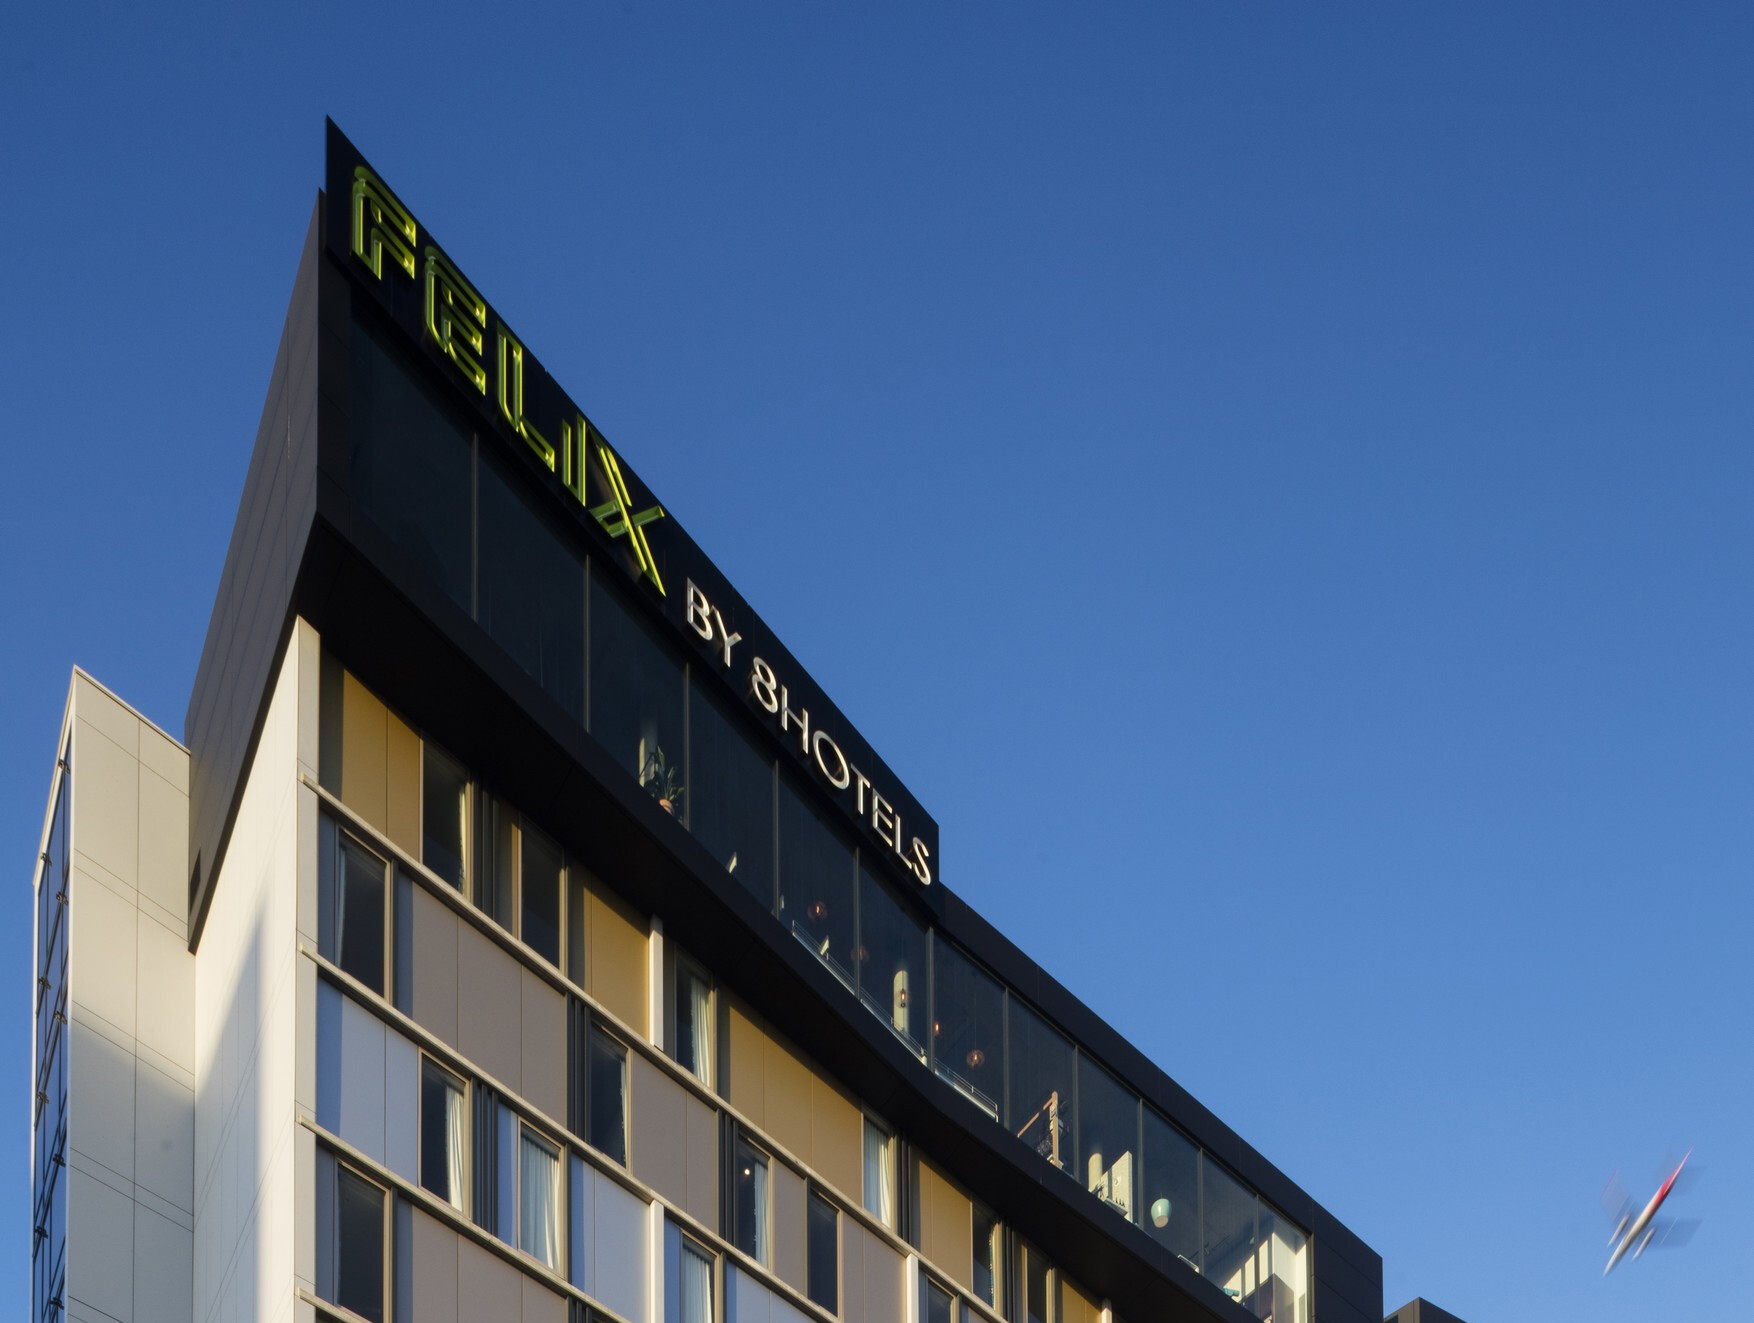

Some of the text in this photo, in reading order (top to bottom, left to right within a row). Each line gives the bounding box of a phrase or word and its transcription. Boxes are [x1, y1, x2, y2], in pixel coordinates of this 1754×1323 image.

[352, 165, 931, 886] FELIX BY 8HOTELS
